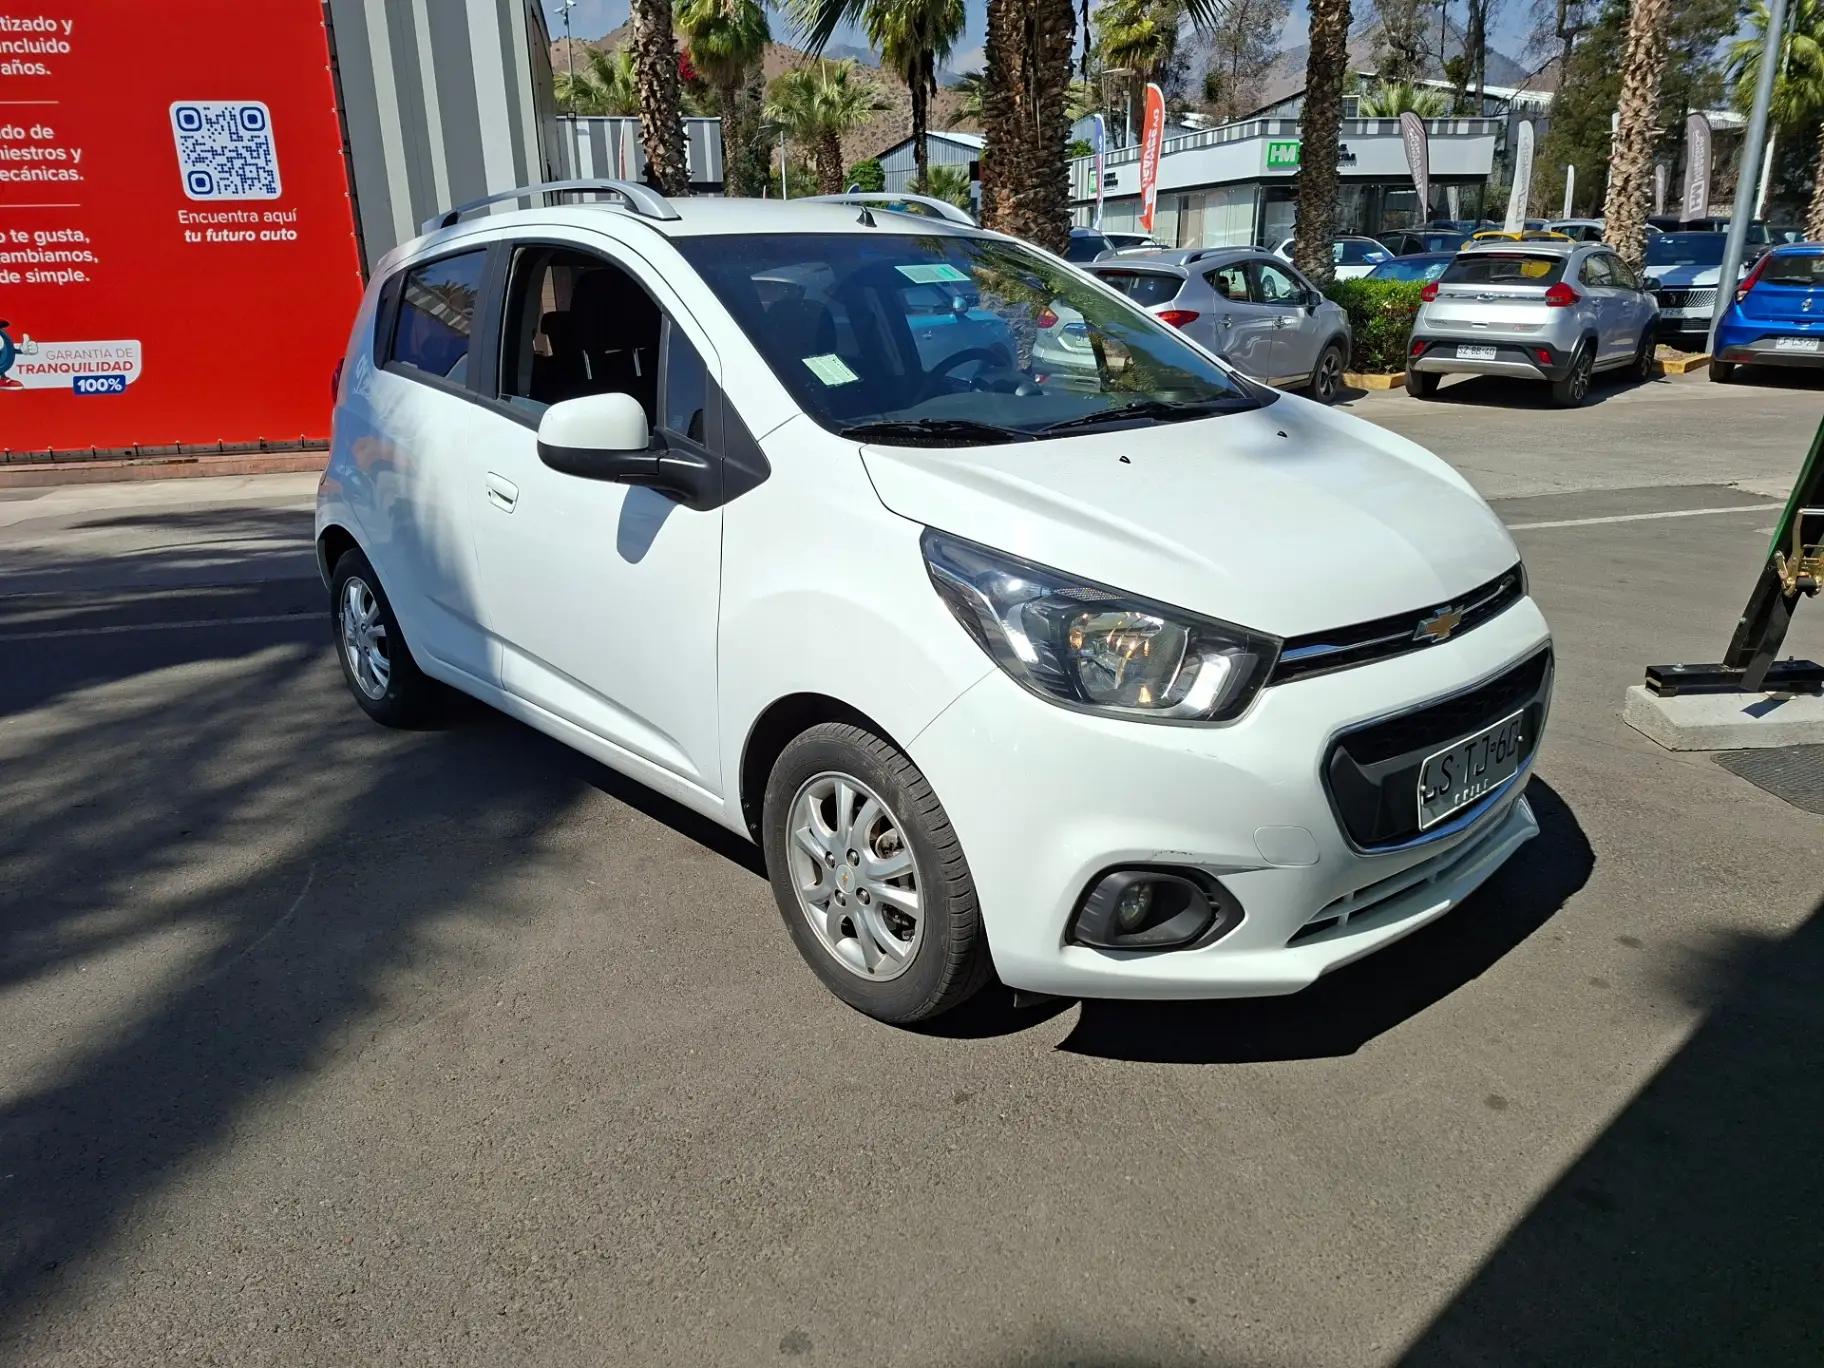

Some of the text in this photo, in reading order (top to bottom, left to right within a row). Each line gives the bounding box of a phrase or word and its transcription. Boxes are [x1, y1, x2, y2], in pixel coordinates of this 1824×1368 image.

[61, 19, 72, 35] y
[1, 59, 52, 75] años.
[0, 124, 55, 139] do de
[70, 148, 82, 163] y
[178, 207, 298, 227] Encuentra aquí
[10, 229, 30, 243] te
[34, 228, 91, 246] gusta,
[184, 228, 298, 242] tu futuro auto
[25, 267, 91, 286] simple.
[116, 347, 134, 358] DE
[16, 360, 134, 375] TRANQUILIDAD
[77, 377, 123, 393] 100%
